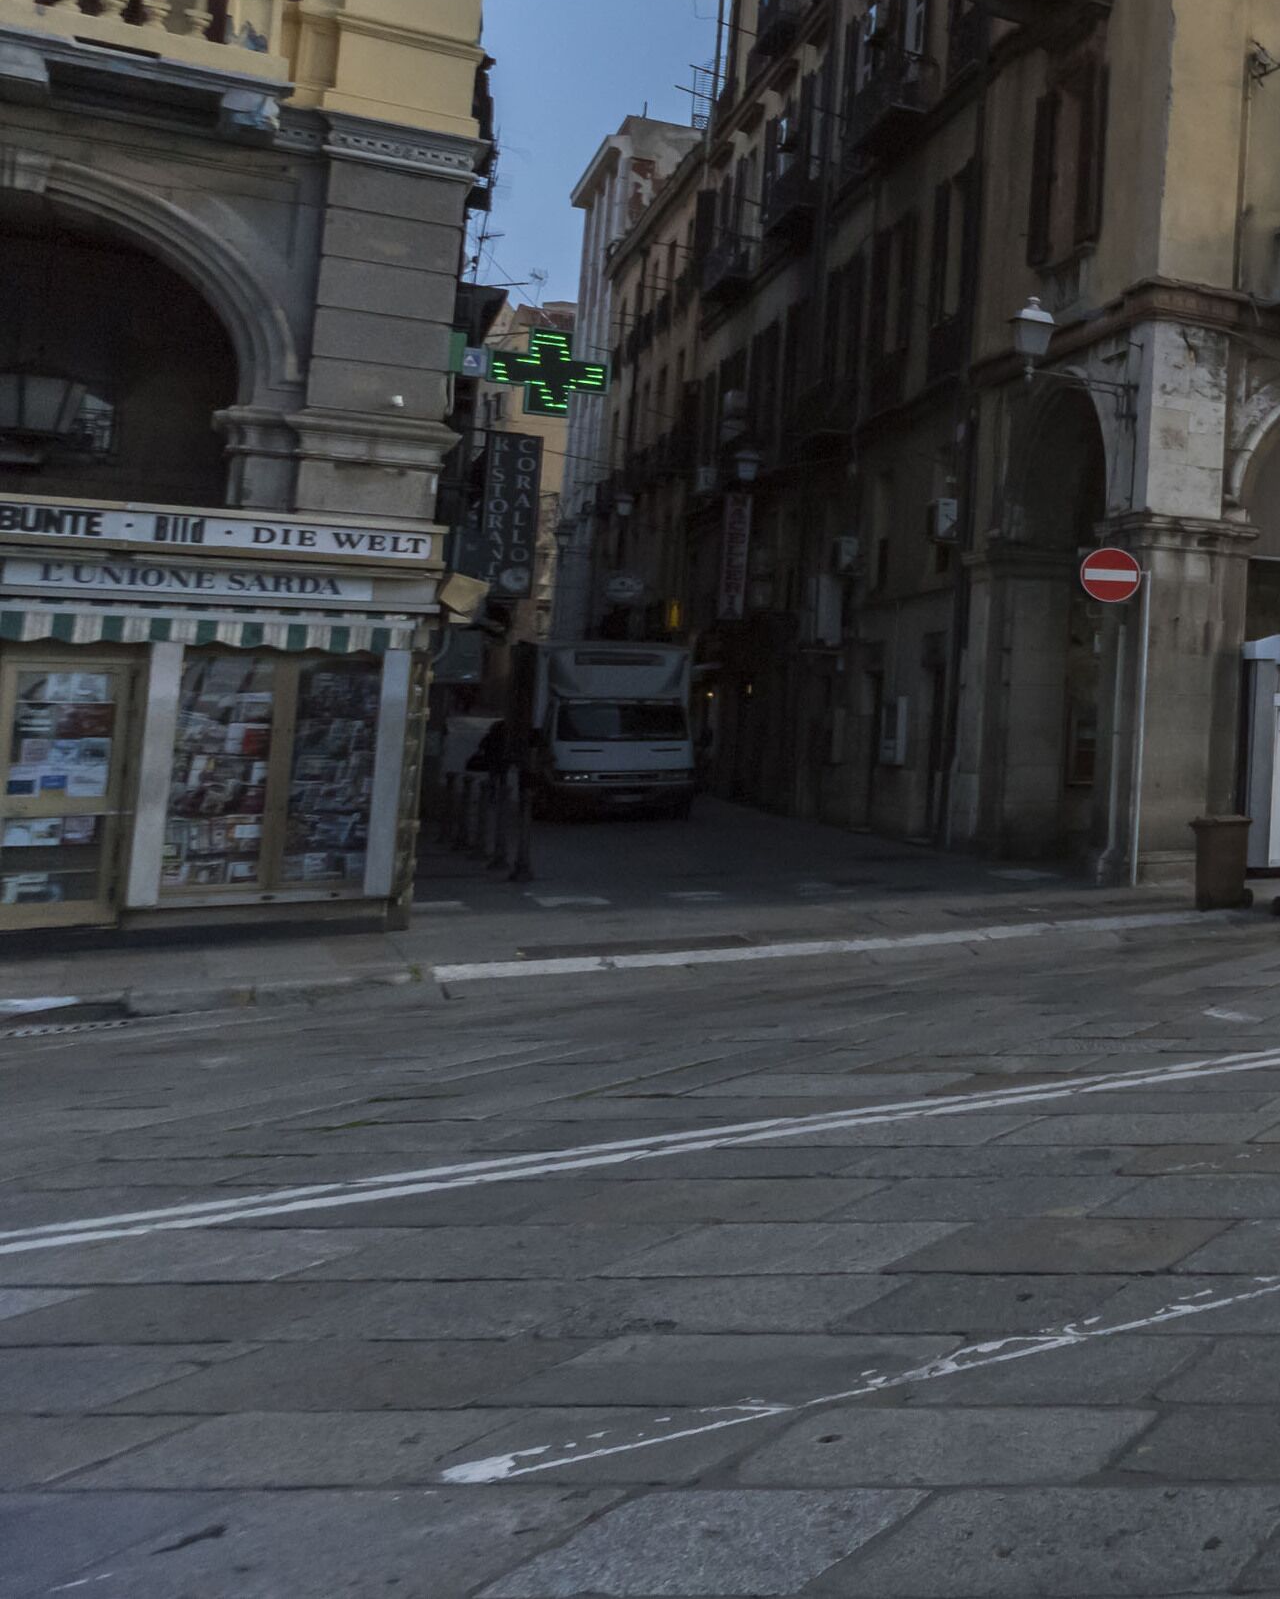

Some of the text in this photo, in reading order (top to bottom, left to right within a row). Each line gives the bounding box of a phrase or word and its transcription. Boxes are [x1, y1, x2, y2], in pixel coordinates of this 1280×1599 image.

[511, 439, 537, 563] CORALLO
[0, 506, 427, 554] BUNTE Bild DIE WELT
[40, 562, 342, 595] L'UNIONE SARDA
